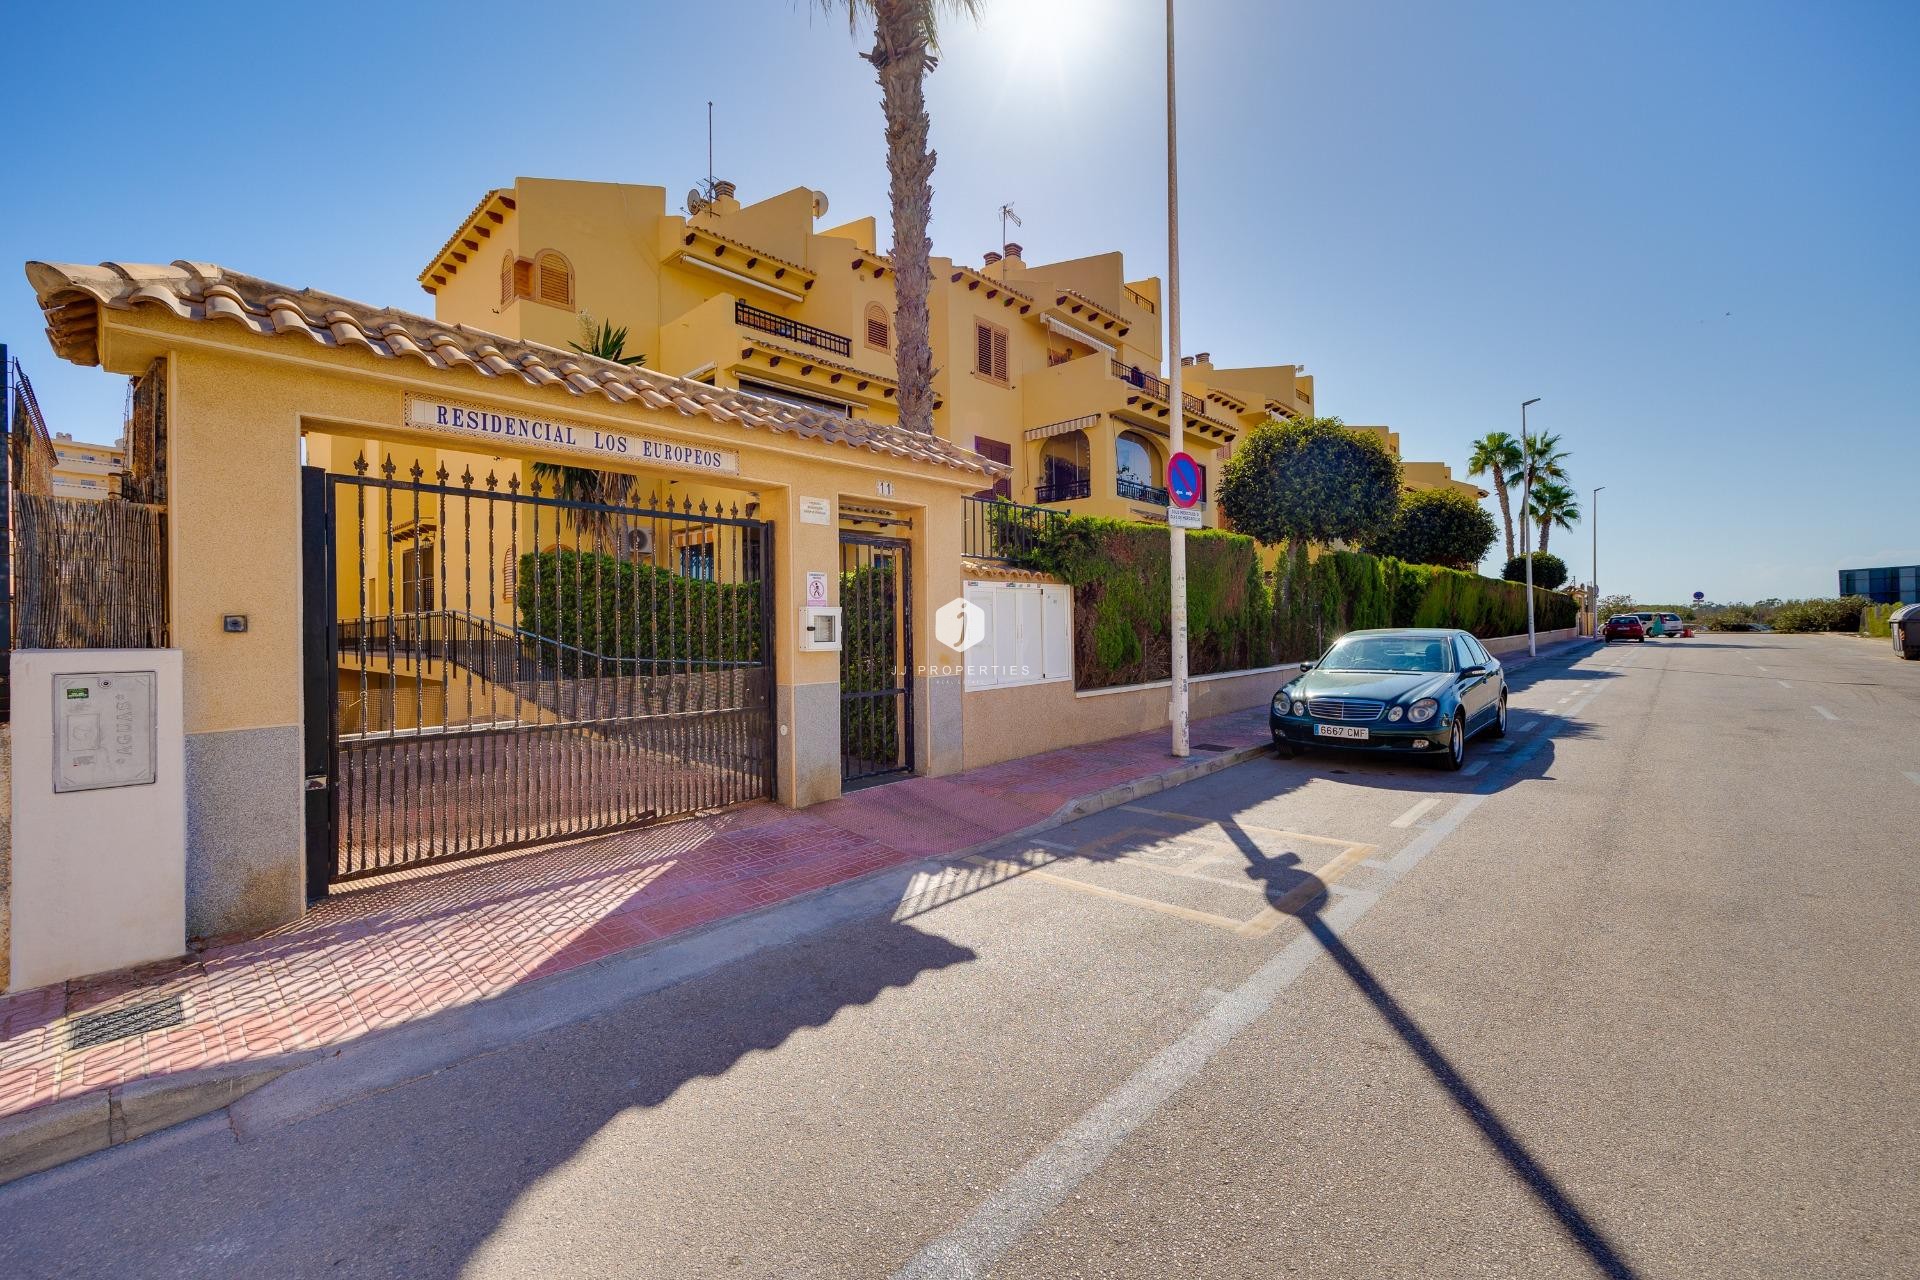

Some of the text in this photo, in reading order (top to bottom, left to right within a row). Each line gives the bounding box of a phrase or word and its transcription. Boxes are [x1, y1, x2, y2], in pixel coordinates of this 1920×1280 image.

[437, 405, 721, 468] RESIDENCIAL LOS EUROPEOS
[880, 482, 891, 495] 11
[1320, 726, 1366, 737] 6667 CMF
